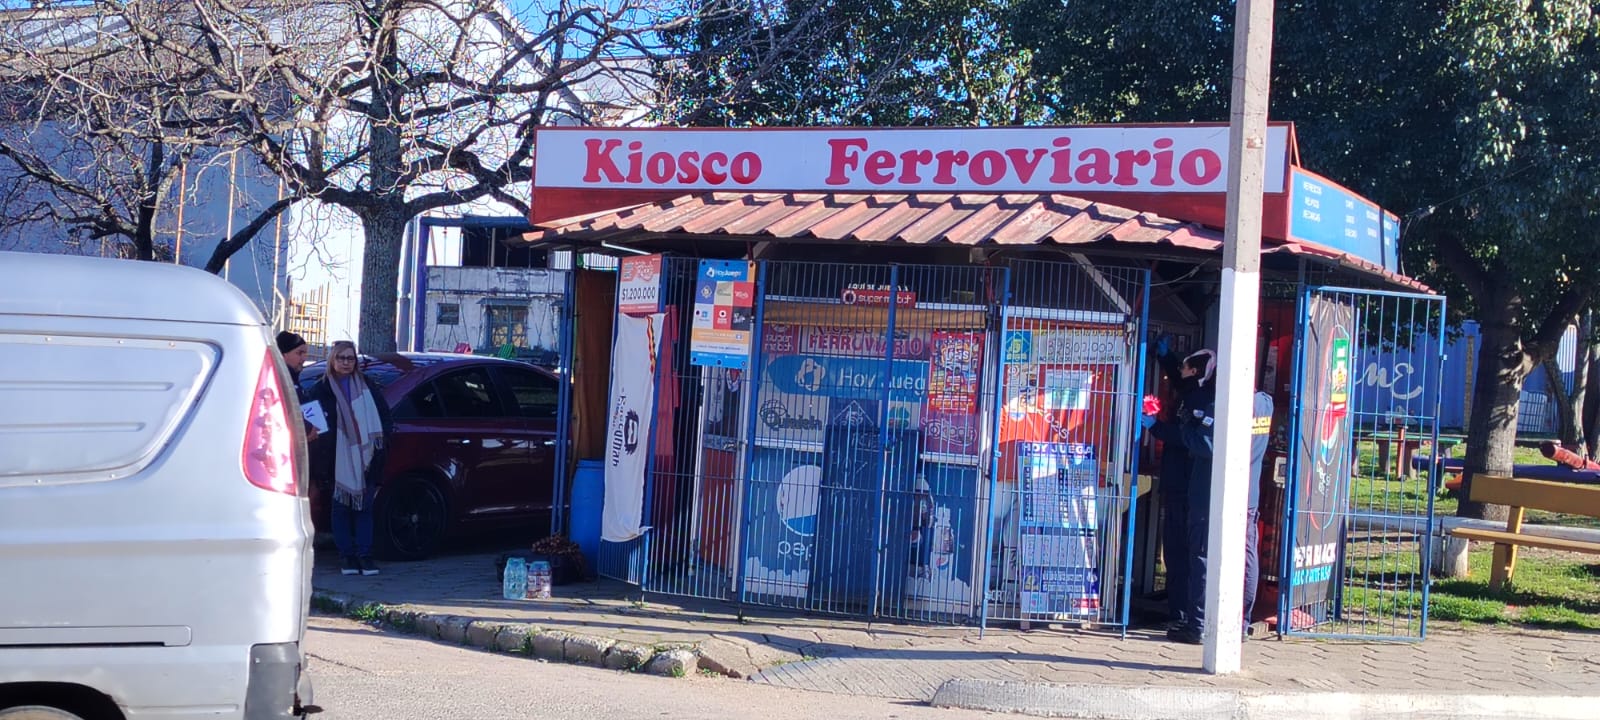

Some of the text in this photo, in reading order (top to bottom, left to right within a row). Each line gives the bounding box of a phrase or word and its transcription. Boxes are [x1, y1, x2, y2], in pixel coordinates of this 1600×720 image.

[583, 137, 1222, 187] Kiosco Ferroviario
[621, 287, 656, 302] $1.200.000
